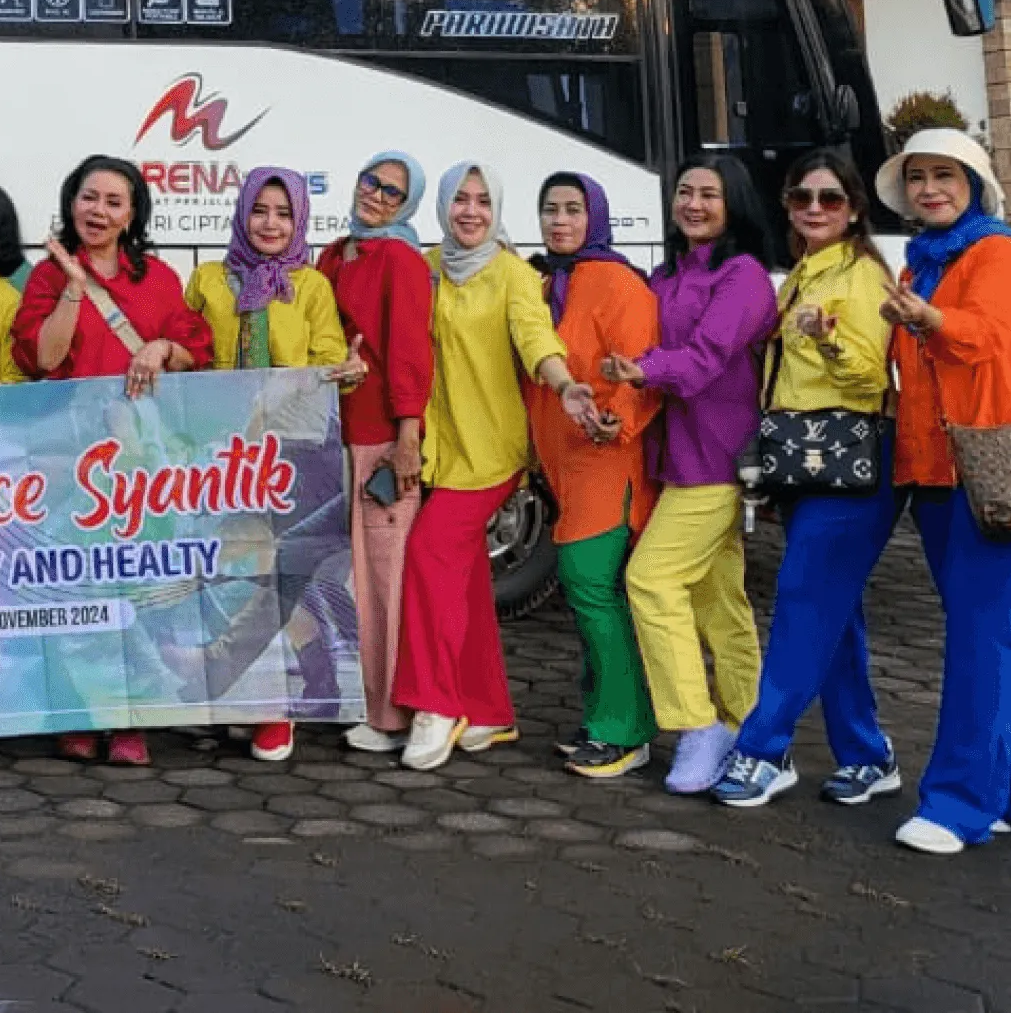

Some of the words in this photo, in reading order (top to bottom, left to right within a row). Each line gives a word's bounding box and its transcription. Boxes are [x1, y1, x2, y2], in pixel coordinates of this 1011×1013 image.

[139, 161, 241, 195] RENA
[74, 432, 293, 538] Syantik
[11, 548, 84, 586] AND
[92, 540, 219, 581] HEALTY
[70, 605, 110, 626] 2024
